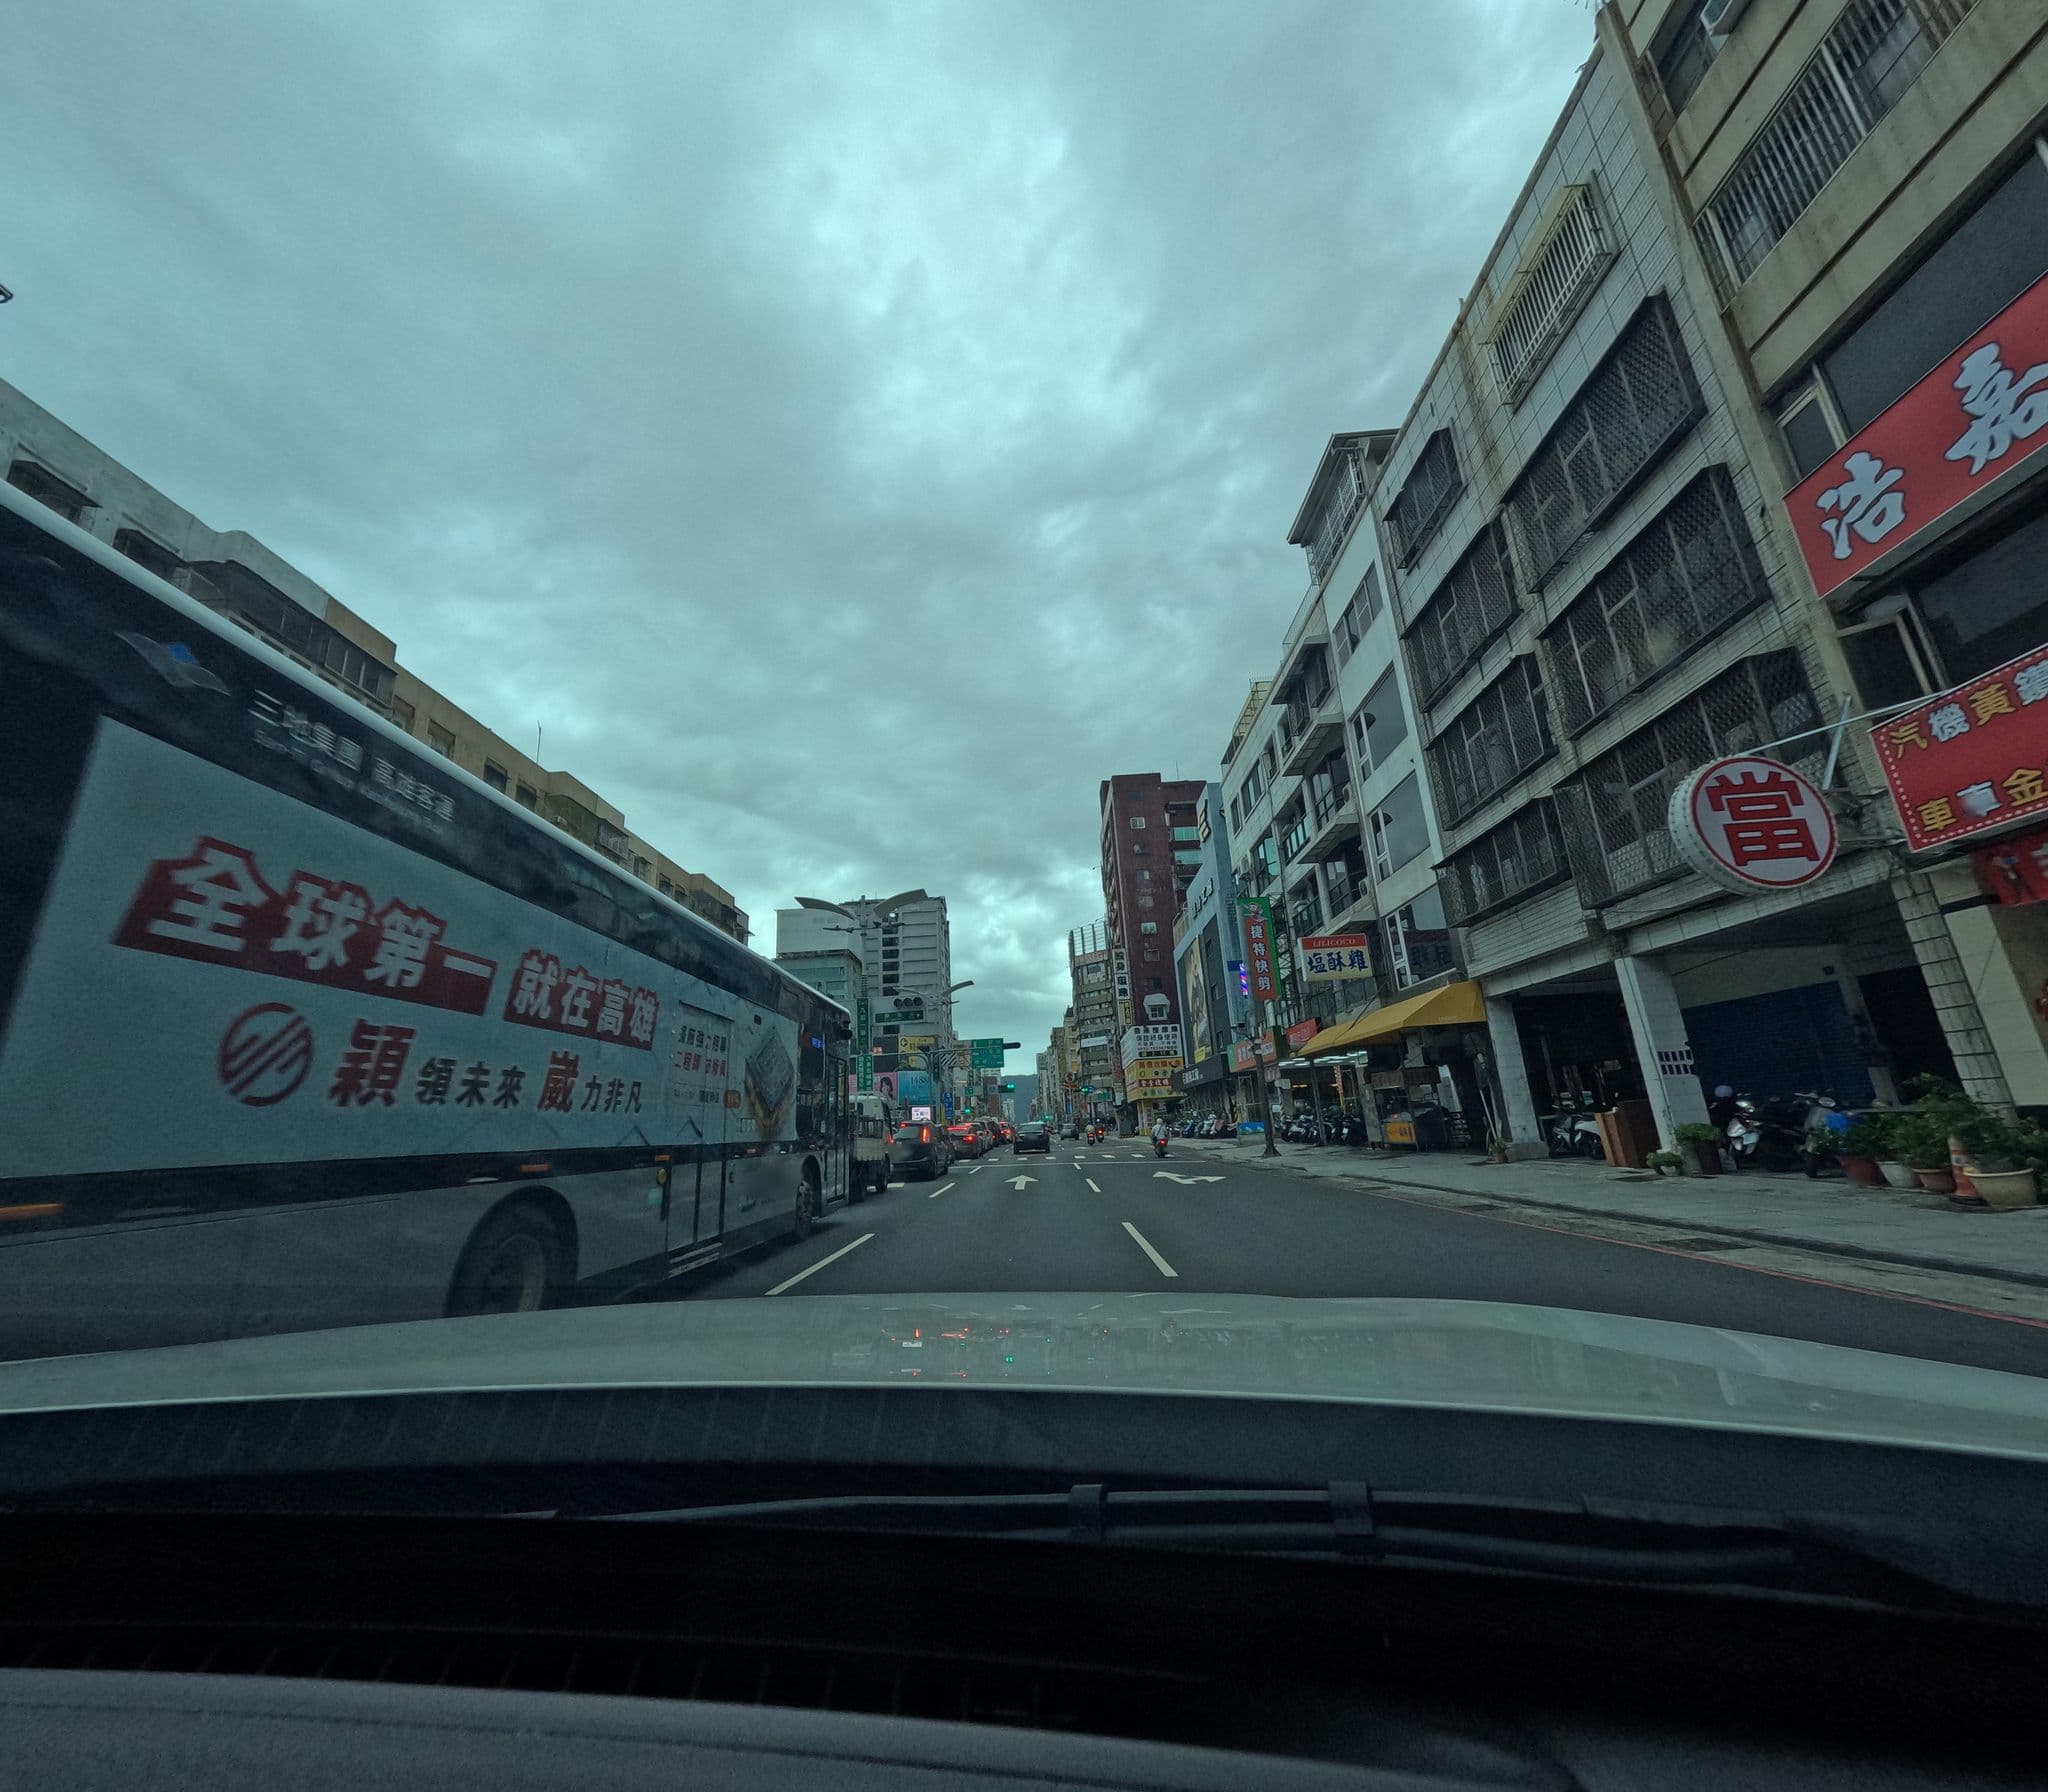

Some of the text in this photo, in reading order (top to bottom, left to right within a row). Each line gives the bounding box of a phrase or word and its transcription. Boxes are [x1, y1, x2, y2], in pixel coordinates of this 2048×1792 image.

[1706, 771, 1821, 867] 當
[146, 848, 658, 1044] 全球第一 就在高雄
